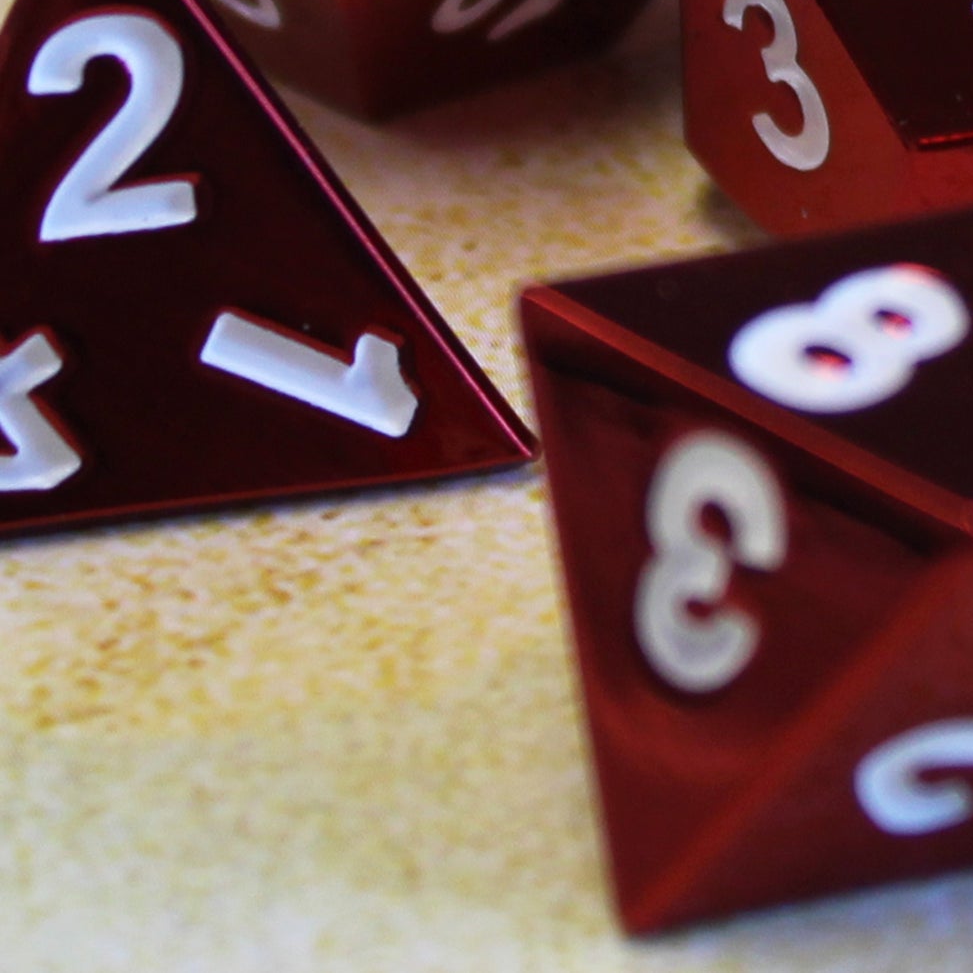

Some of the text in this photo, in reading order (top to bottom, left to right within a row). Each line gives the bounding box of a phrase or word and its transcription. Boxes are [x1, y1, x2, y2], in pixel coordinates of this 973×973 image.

[28, 13, 196, 241] 2
[200, 312, 418, 438] 1
[728, 262, 971, 414] 8
[635, 427, 788, 694] 3
